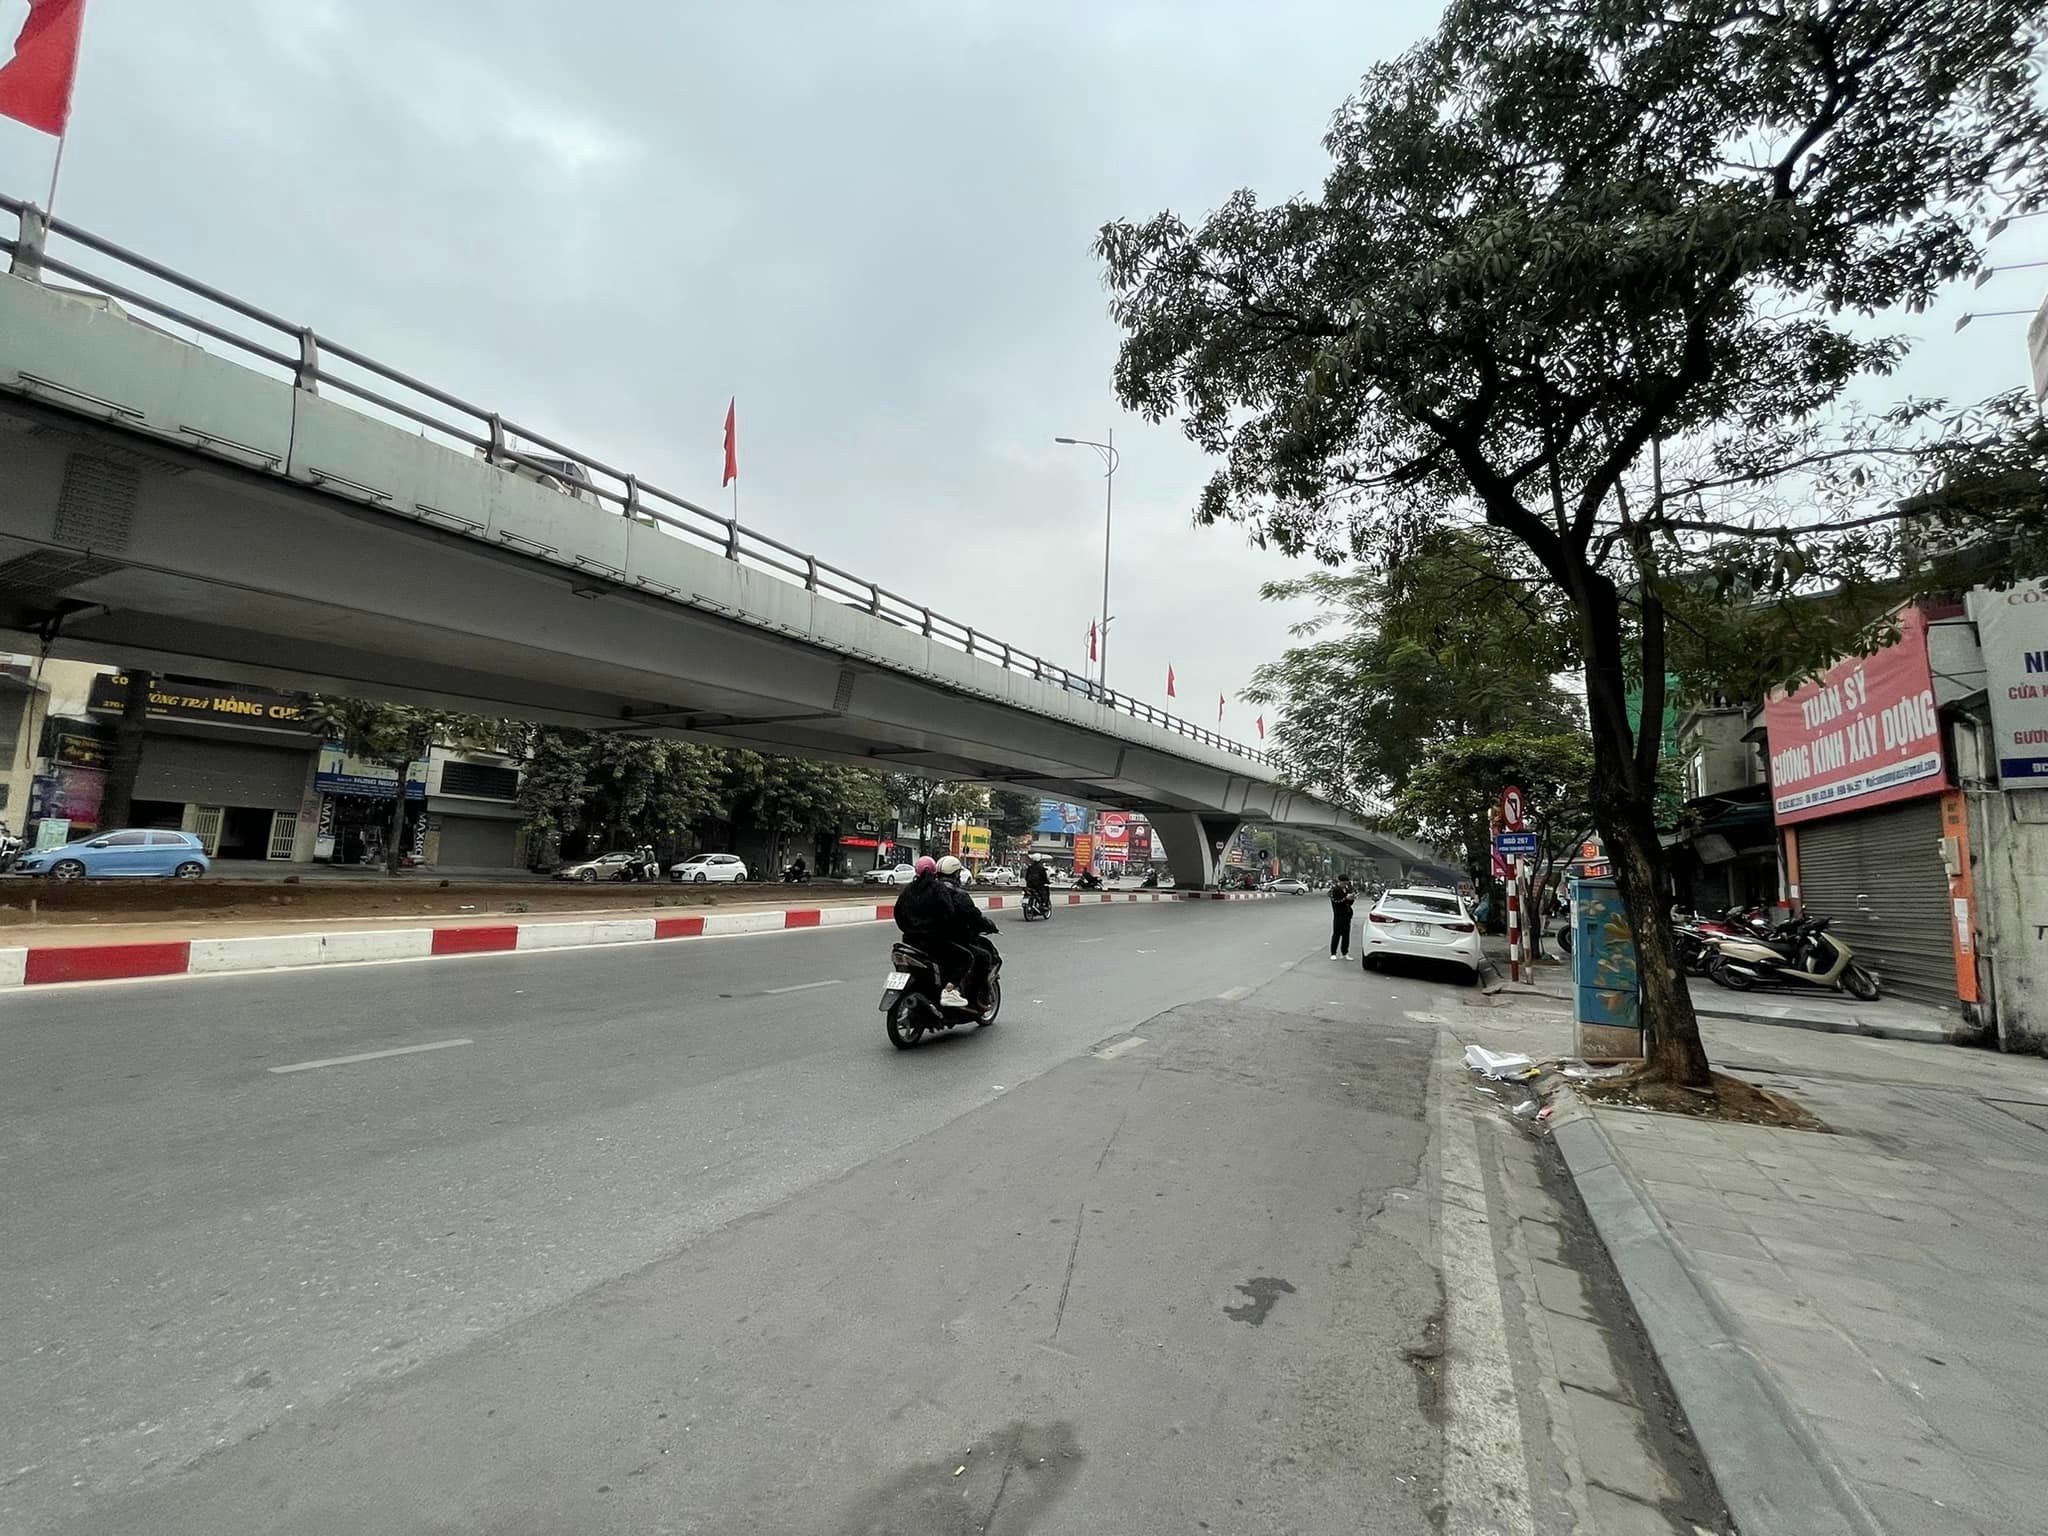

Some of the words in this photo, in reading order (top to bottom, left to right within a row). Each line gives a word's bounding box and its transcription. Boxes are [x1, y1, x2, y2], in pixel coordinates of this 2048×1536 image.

[2007, 589, 2048, 606] CÔ
[1811, 729, 1845, 775] KÍNH
[1846, 712, 1878, 763] XÂY
[1881, 690, 1937, 755] DỰNG
